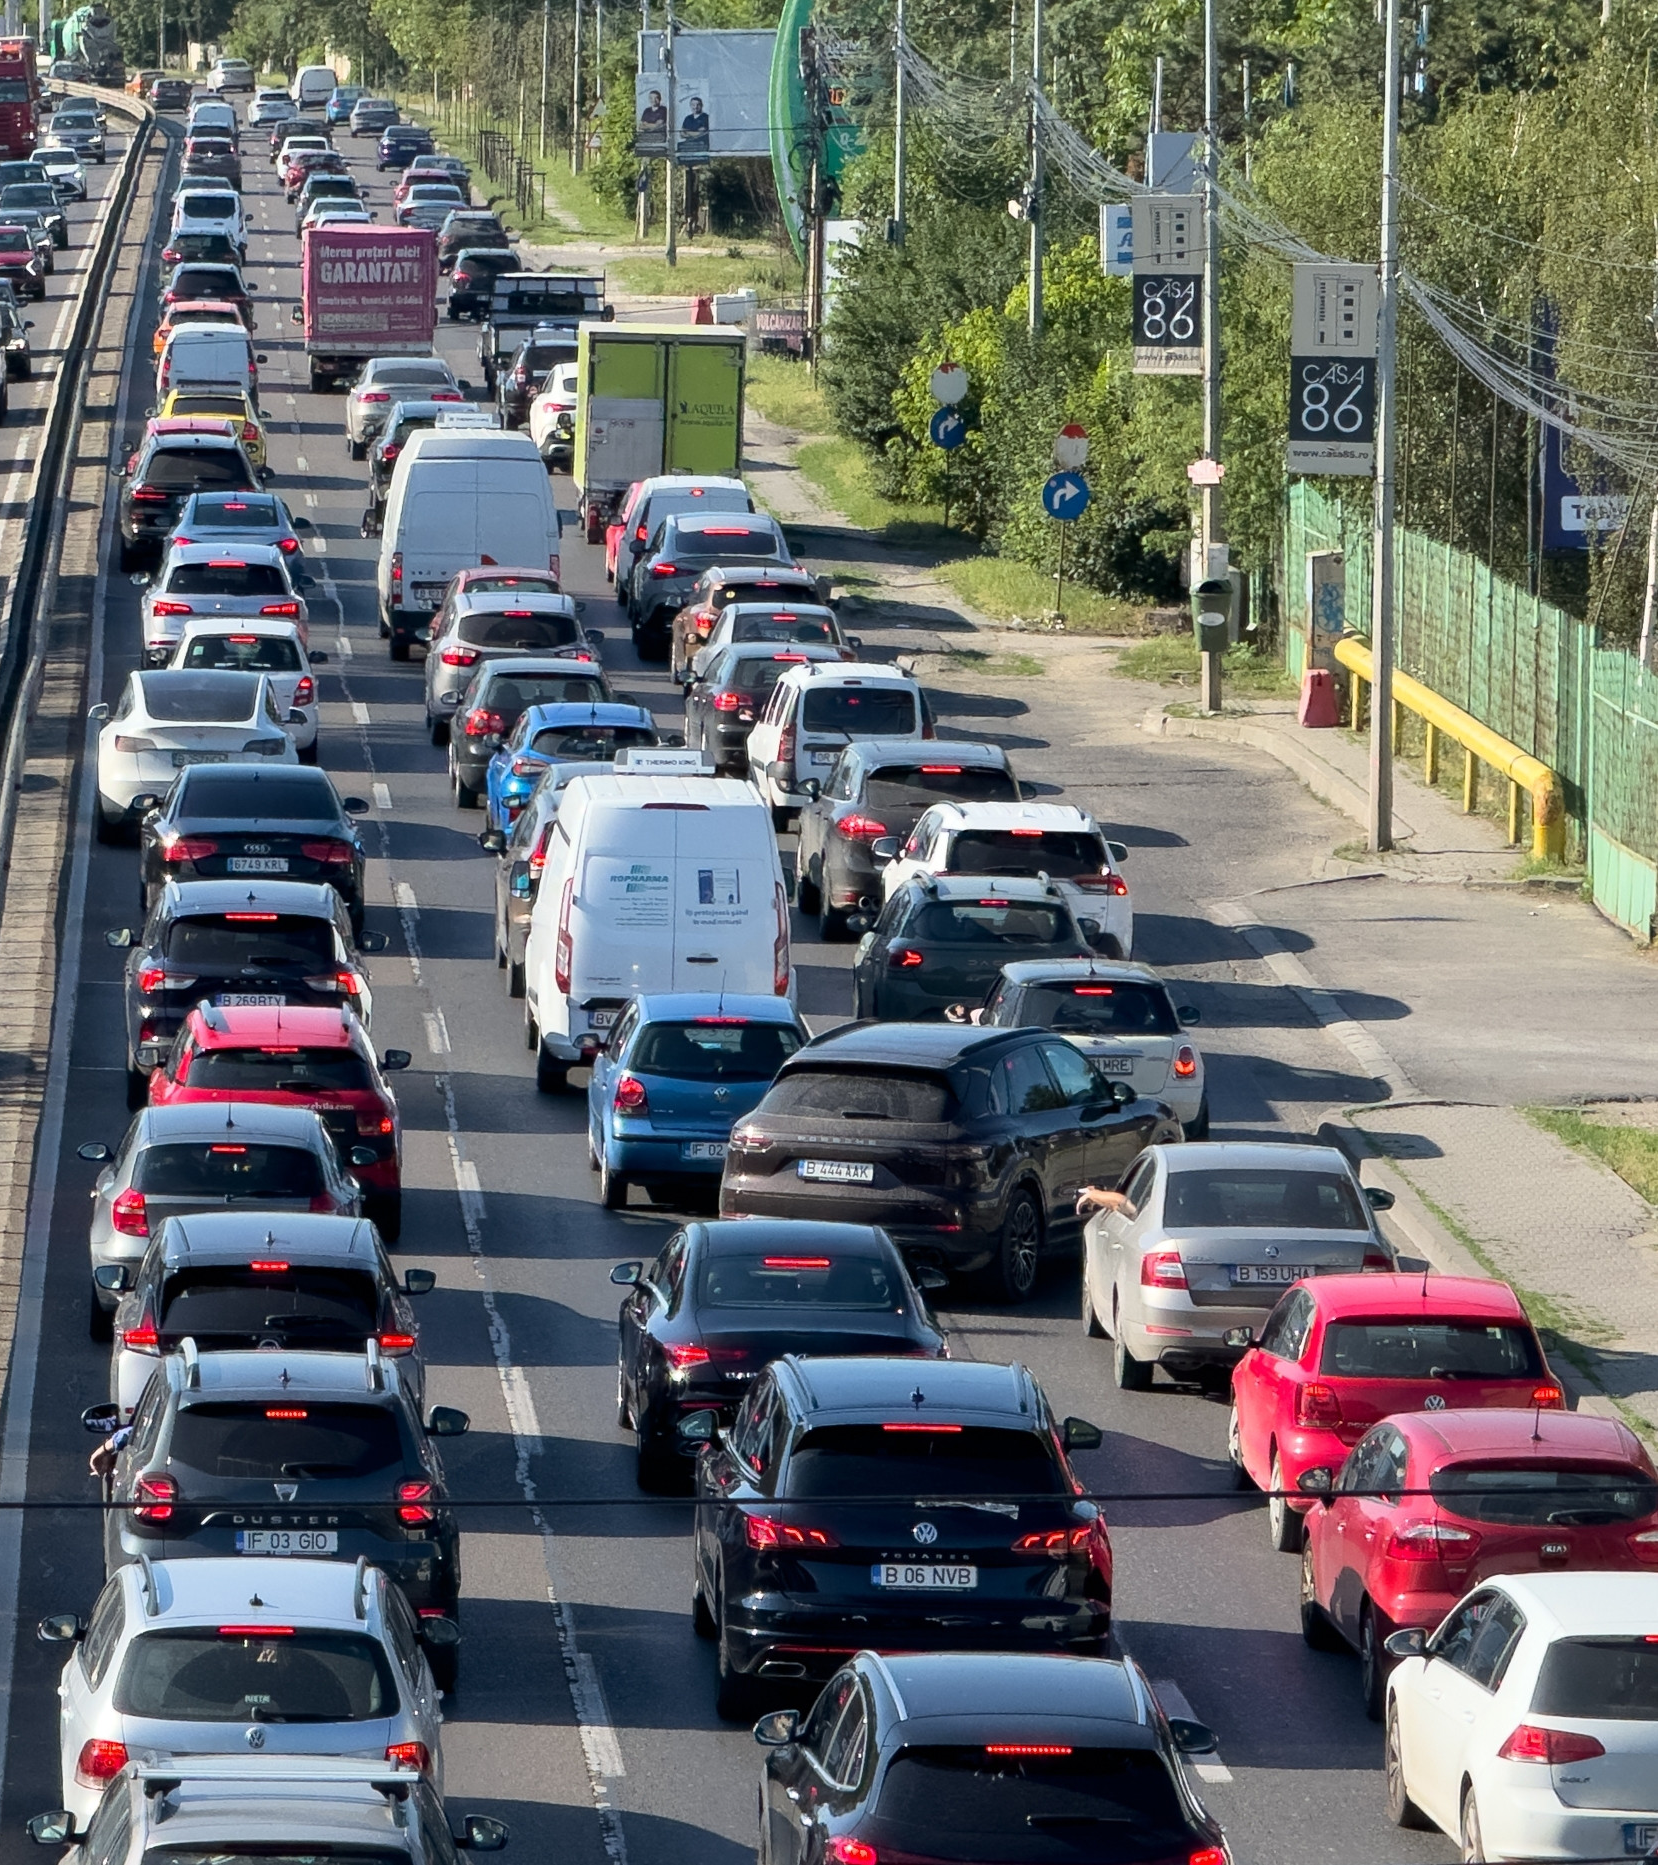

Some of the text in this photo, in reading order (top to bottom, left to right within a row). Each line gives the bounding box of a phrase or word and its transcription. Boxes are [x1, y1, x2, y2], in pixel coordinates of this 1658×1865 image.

[321, 262, 419, 283] GARANTAT!
[1143, 298, 1195, 339] 86
[692, 404, 735, 415] AQUILA
[1302, 383, 1363, 432] 86
[645, 758, 697, 767] THERMO KING
[234, 860, 287, 870] 6749 KRL
[610, 875, 669, 883] ROPHARMA
[223, 995, 231, 1006] B
[595, 1014, 613, 1025] BV
[1104, 1059, 1128, 1072] MRE
[692, 1143, 724, 1156] IF 02
[806, 1161, 869, 1179] B 444 AAK
[1239, 1267, 1311, 1281] B 159 UHA
[233, 1515, 339, 1524] DUSTER
[247, 1532, 327, 1550] IF 03 GIO
[1545, 1544, 1564, 1554] KIA
[885, 1566, 971, 1585] B 06 NVB
[1639, 1827, 1658, 1848] IF
